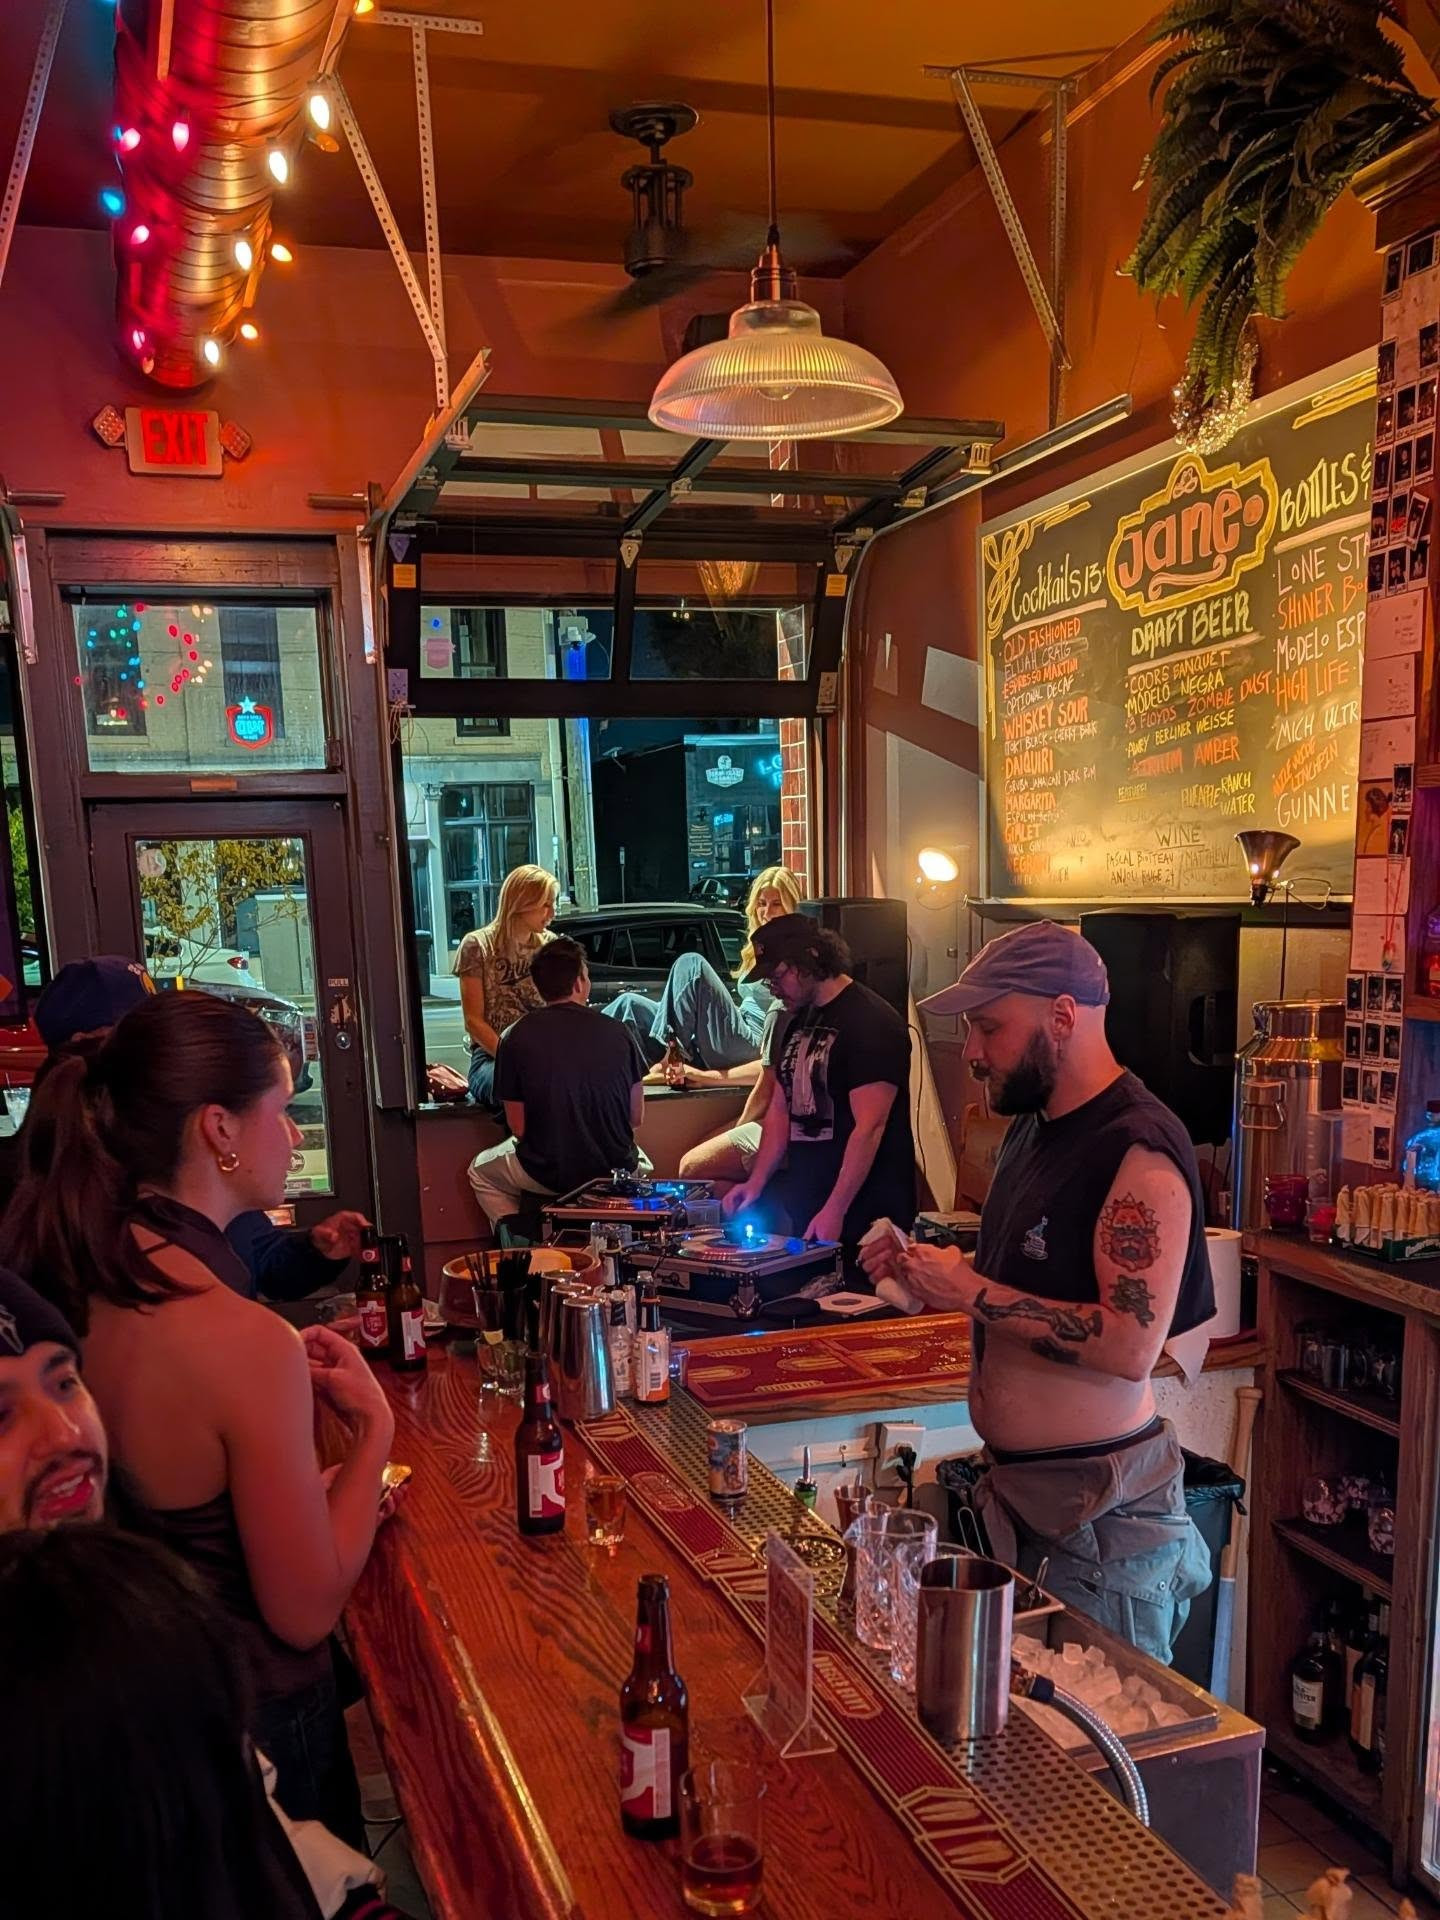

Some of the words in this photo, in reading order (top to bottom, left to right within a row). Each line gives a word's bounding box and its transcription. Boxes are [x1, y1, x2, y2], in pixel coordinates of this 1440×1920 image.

[141, 410, 208, 465] EXIT
[1281, 453, 1358, 532] BOTTLES
[1012, 553, 1081, 622] Cocktails
[1278, 582, 1334, 630] SHINER
[1004, 635, 1025, 662] OLD
[1029, 617, 1080, 647] FASHIONED
[1131, 607, 1187, 658] DRAFT
[1191, 590, 1253, 645] BEER
[1004, 656, 1036, 681] ELIJAH
[1042, 642, 1071, 666] CRAIG
[1130, 666, 1170, 695] COORS
[1173, 651, 1231, 680] BANQUET
[1004, 671, 1041, 698] ESPRESSO
[1006, 689, 1043, 716] OPTIONAL
[1047, 675, 1074, 699] DECAF
[1127, 684, 1170, 718] MODELO
[1181, 669, 1225, 698] NEGRA
[1140, 706, 1177, 729] FLOYDS
[1188, 687, 1234, 718] ZOMBIE
[1240, 670, 1272, 702] DUST
[1276, 667, 1308, 714] HIGH
[1316, 659, 1350, 696] LIFE
[1004, 700, 1053, 739] WHISKEY
[1058, 696, 1088, 727] SOUR
[1155, 720, 1191, 746] BERLINER
[1196, 709, 1235, 735] WEISSE
[1276, 712, 1314, 750] MICH
[1005, 747, 1053, 779] DAIQUIRI
[1193, 735, 1241, 768] AMBER
[1005, 791, 1056, 811] MARGARITA
[1221, 771, 1251, 795] RANCH
[1221, 793, 1255, 816] WATER
[1277, 782, 1350, 828] GUINNE
[1155, 822, 1201, 846] WINE
